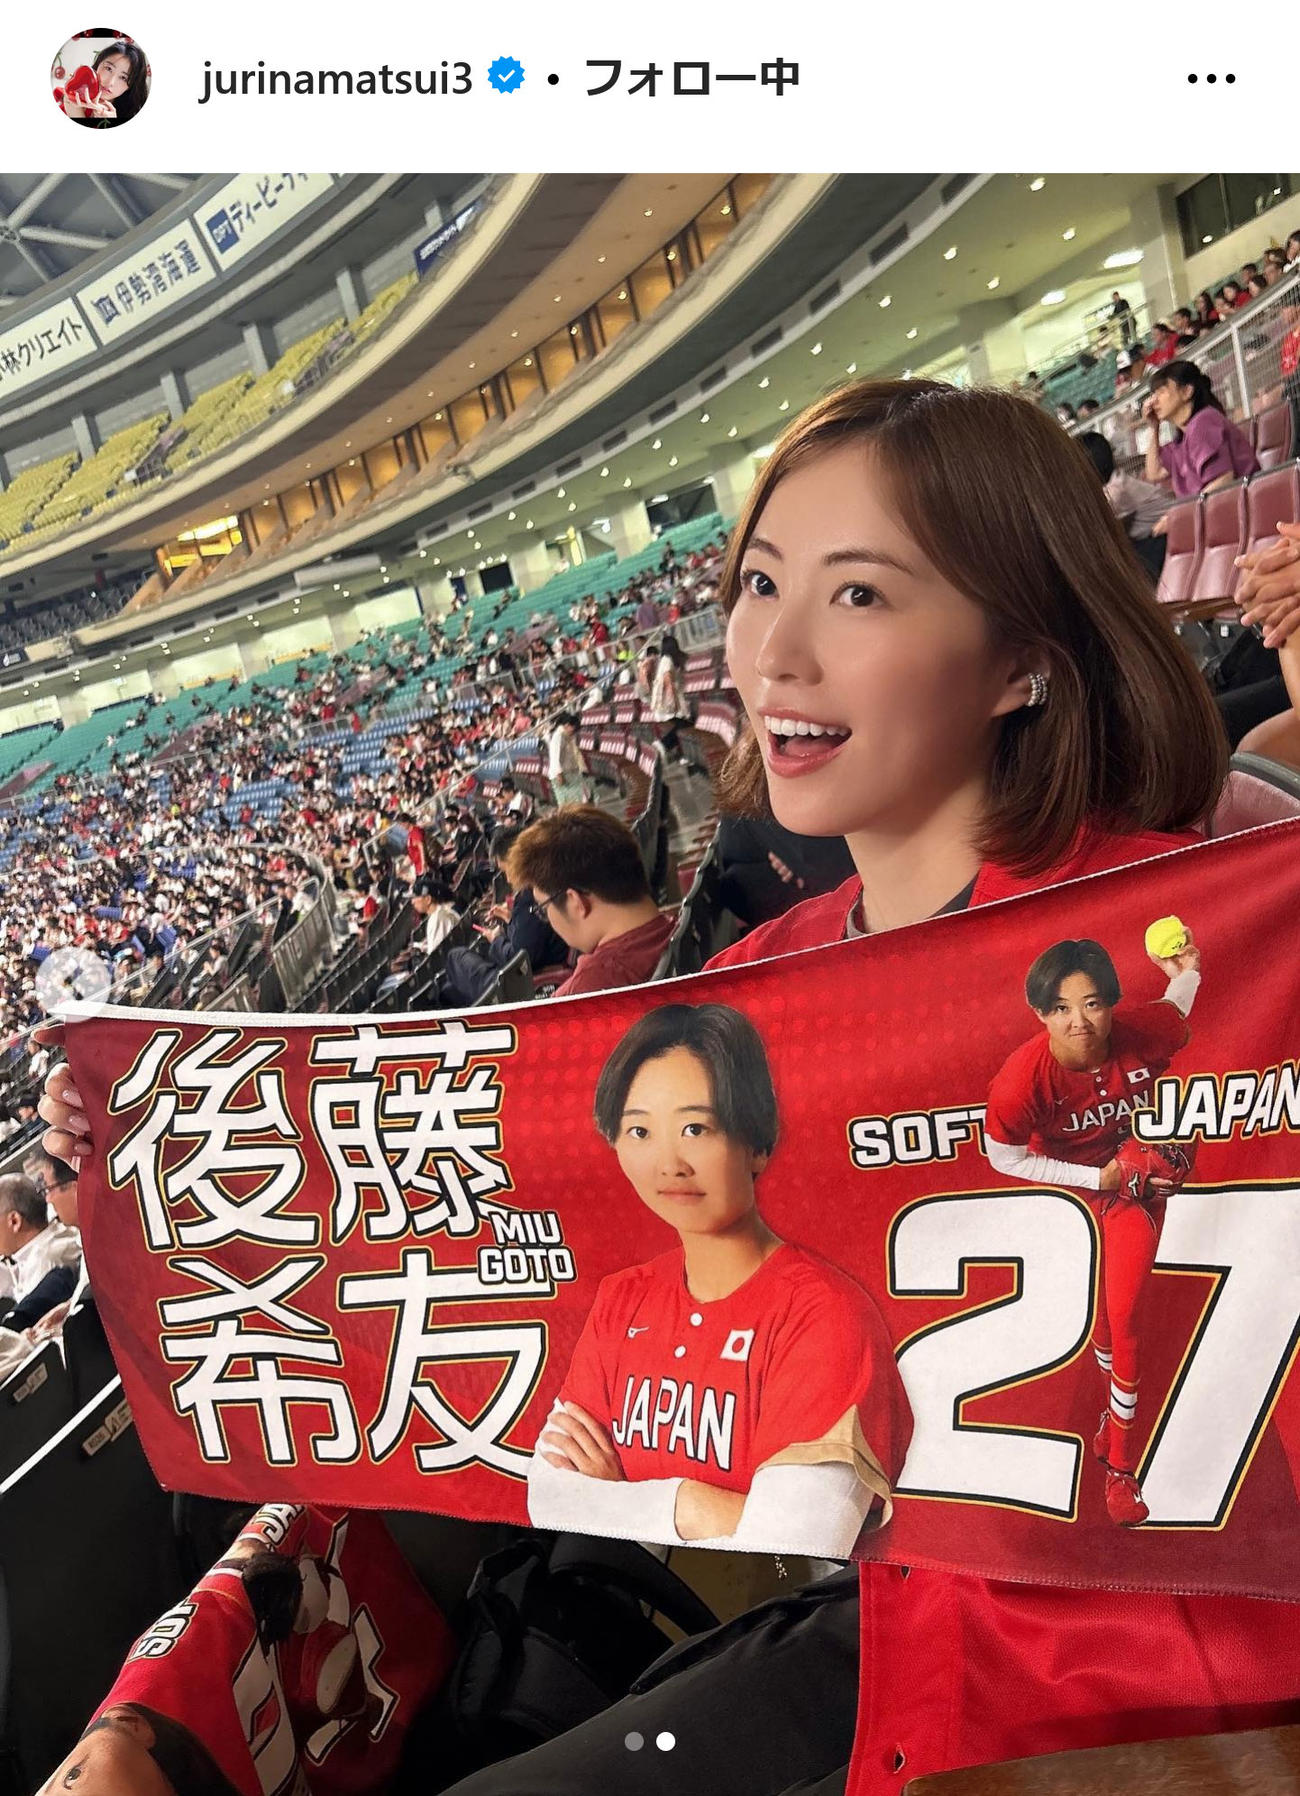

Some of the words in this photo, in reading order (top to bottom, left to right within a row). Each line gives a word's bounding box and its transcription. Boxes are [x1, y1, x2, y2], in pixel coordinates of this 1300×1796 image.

[107, 1020, 518, 1252] 後藤
[1062, 1089, 1149, 1132] JAPAN
[488, 1210, 564, 1246] MIU
[477, 1245, 578, 1285] GOTO
[158, 1249, 558, 1479] 希友
[612, 1374, 738, 1472] JAPAN
